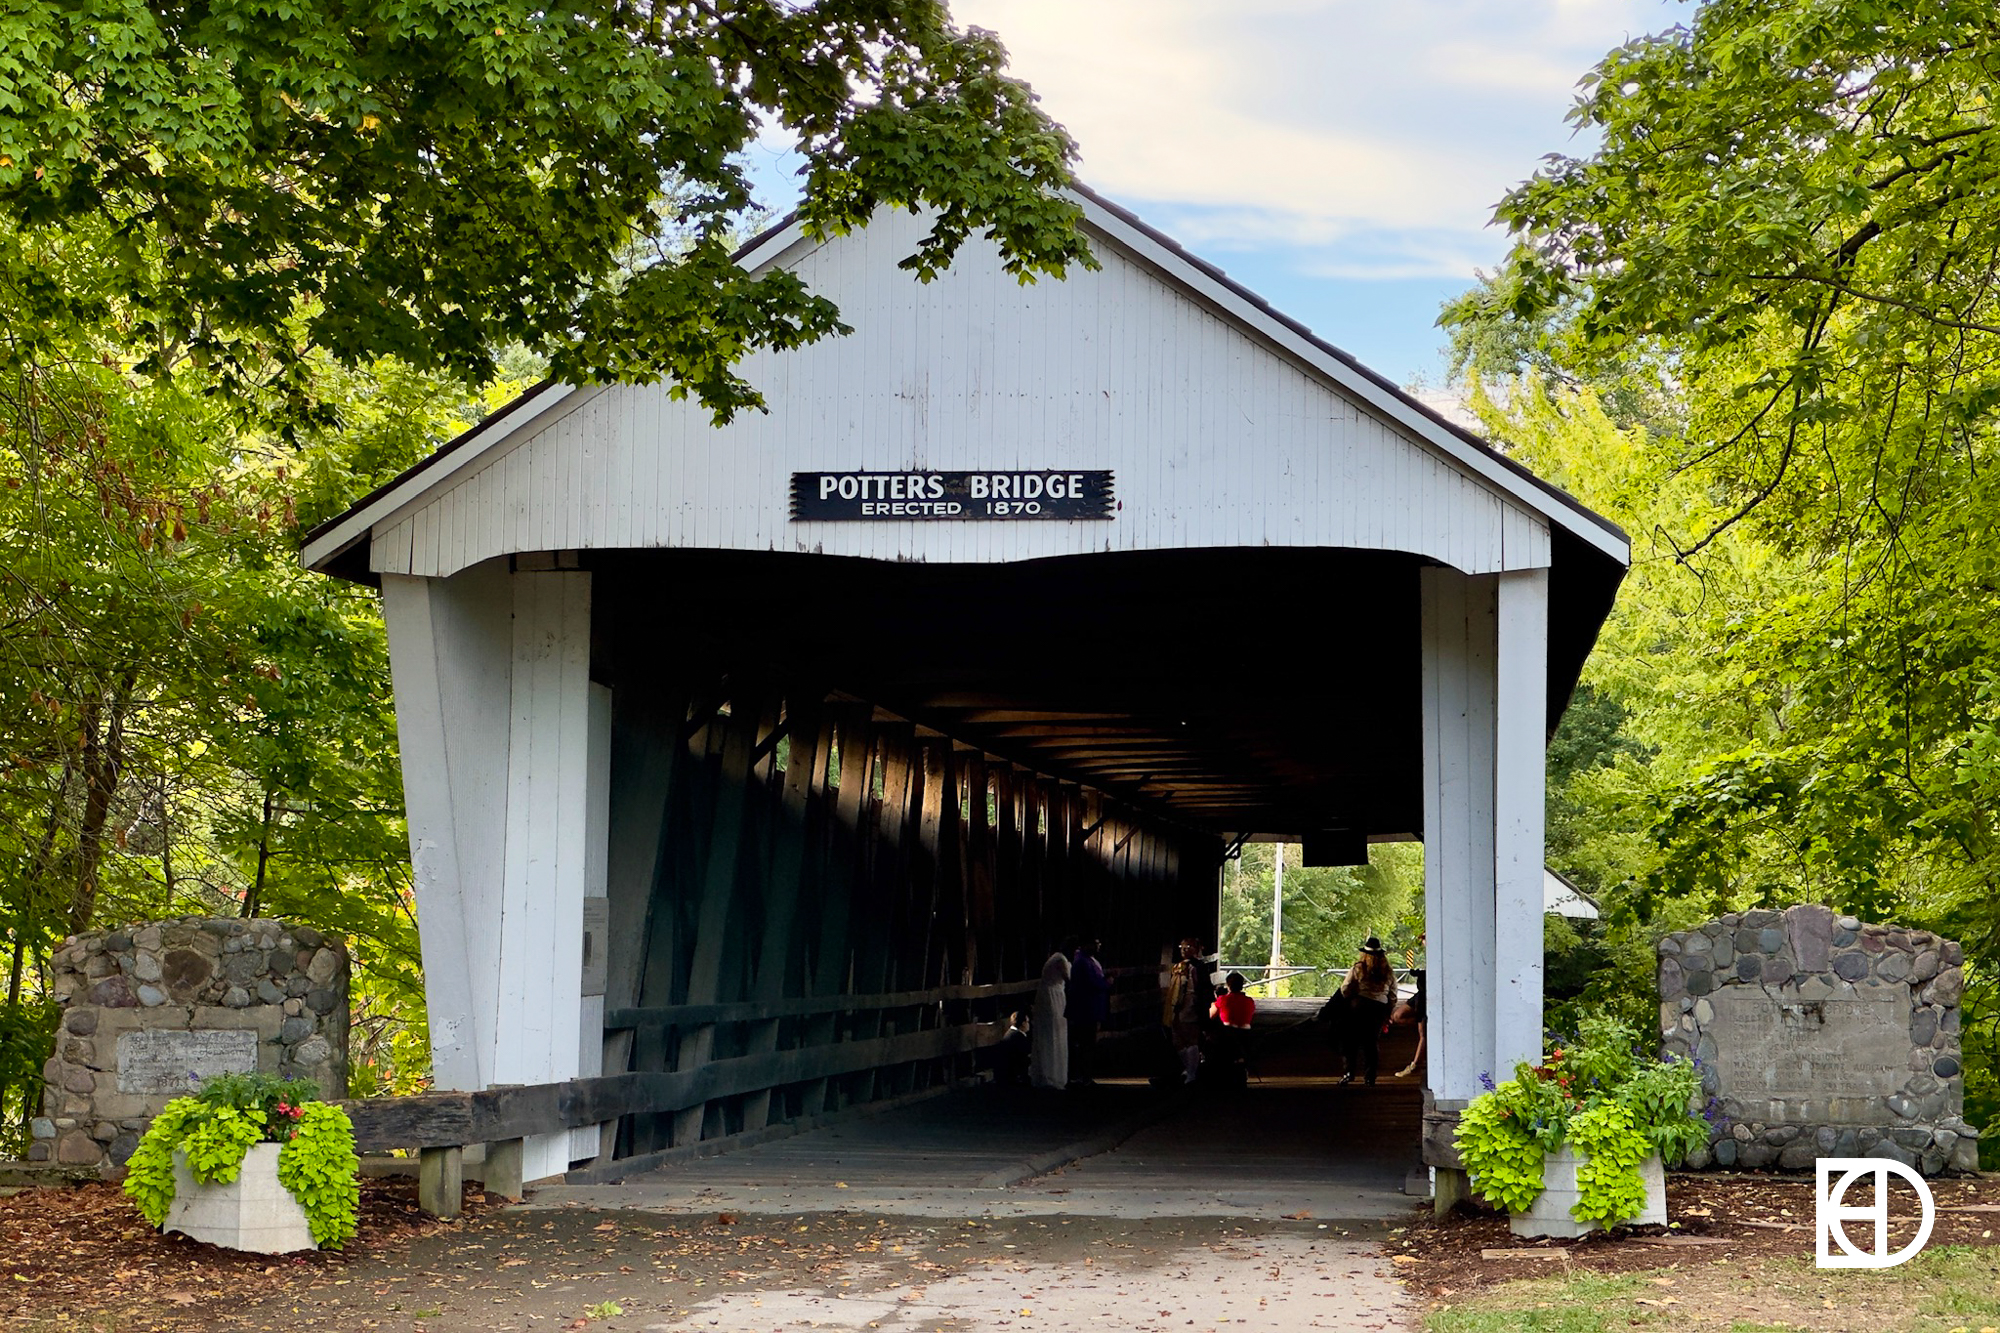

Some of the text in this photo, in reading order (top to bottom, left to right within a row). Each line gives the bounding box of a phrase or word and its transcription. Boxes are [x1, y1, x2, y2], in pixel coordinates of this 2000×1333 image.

[819, 475, 1084, 500] POTTERS BRIDGE
[861, 501, 1042, 515] ERECTED 1870
